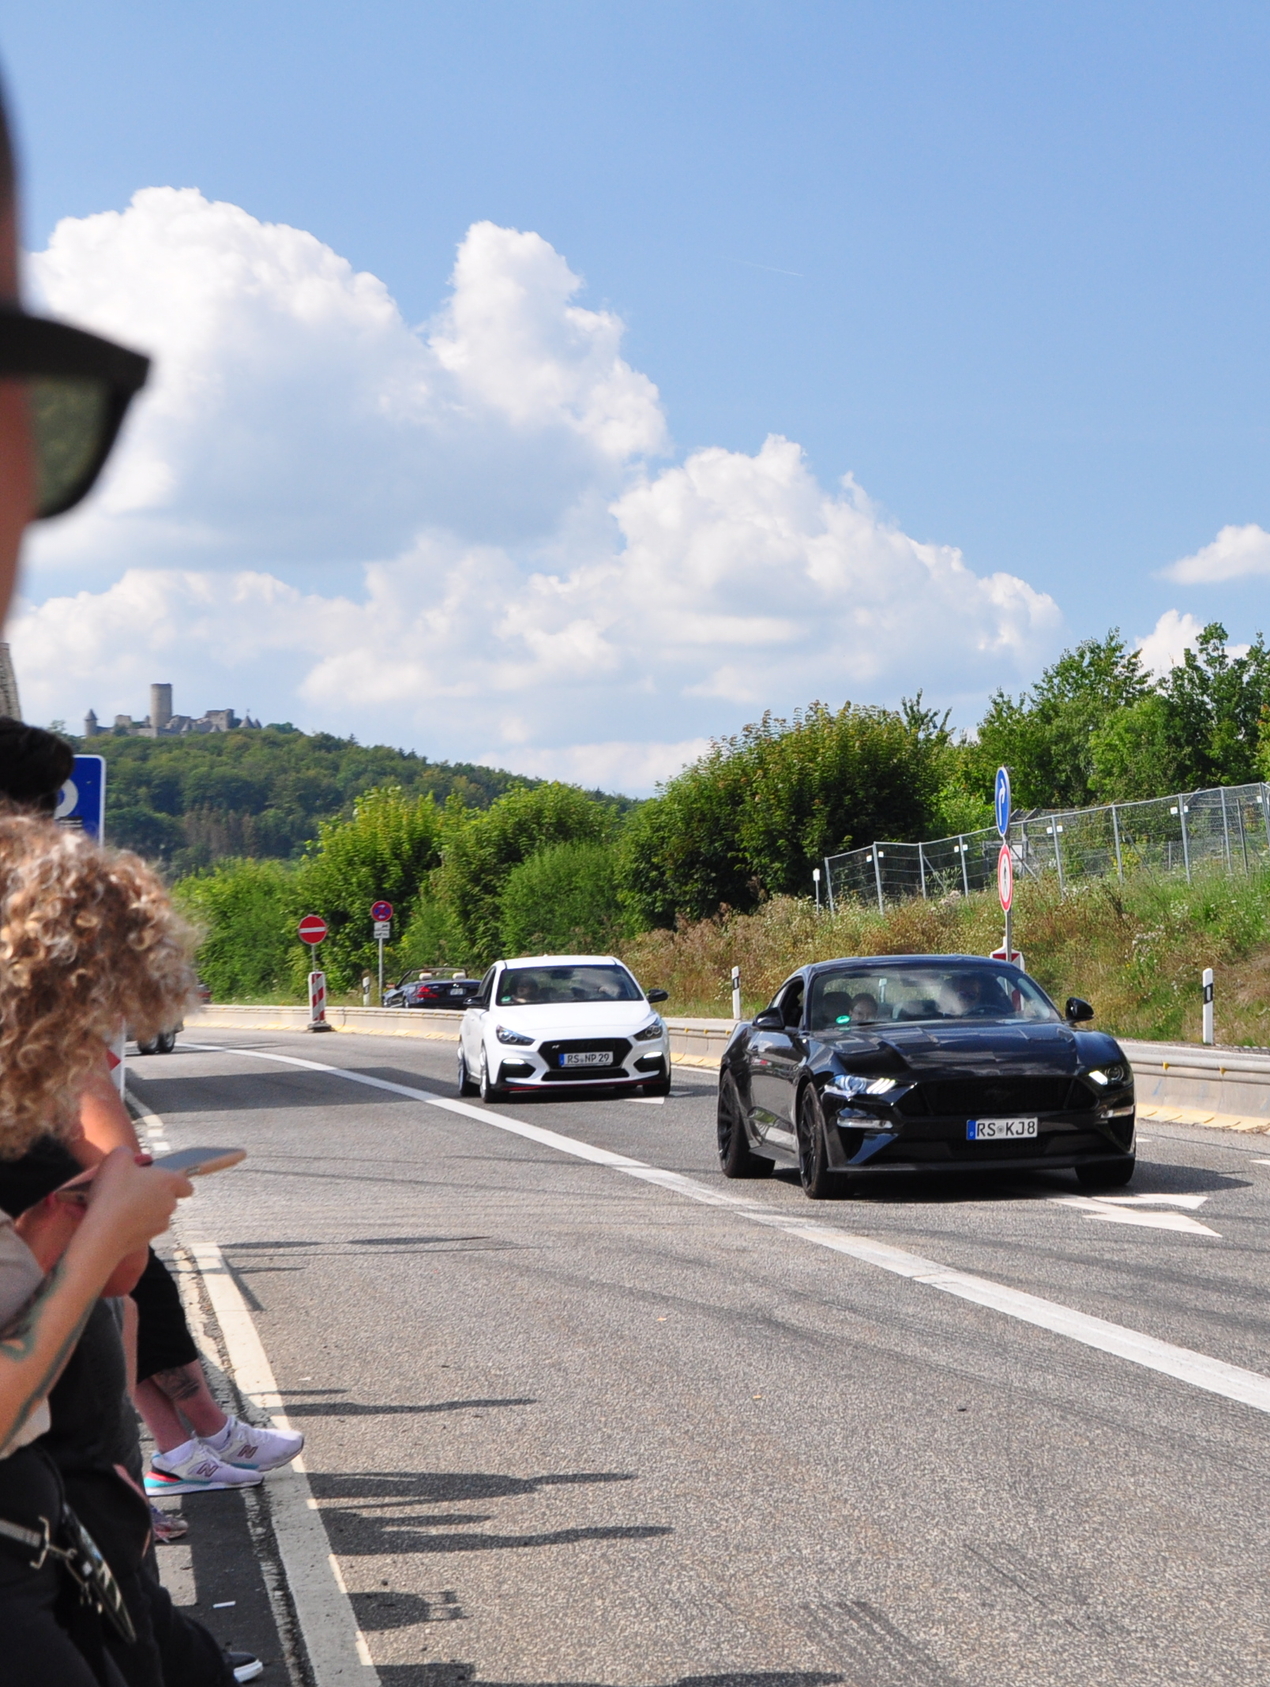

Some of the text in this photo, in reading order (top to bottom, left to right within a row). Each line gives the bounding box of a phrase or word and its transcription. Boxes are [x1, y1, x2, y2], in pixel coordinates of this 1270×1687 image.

[567, 1054, 579, 1064] RS
[977, 1121, 1036, 1137] RS KJ8
[237, 1445, 258, 1459] N
[196, 1463, 219, 1478] N
